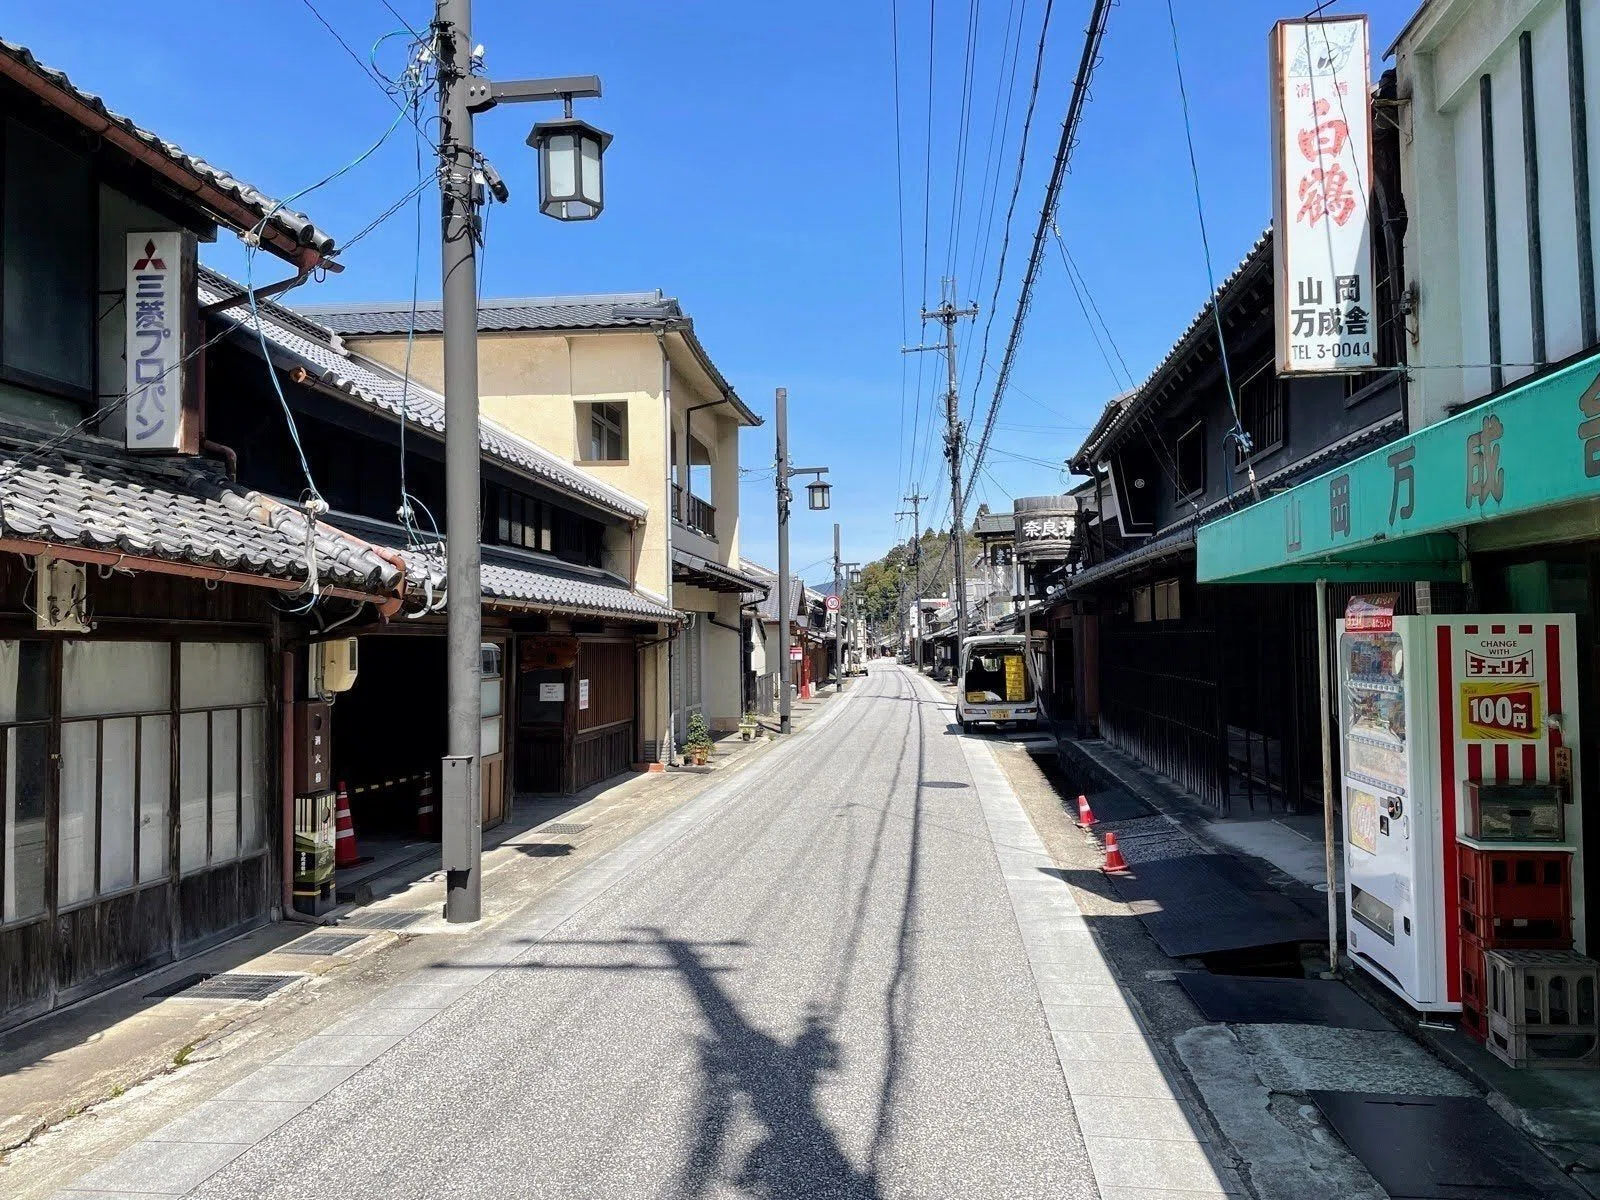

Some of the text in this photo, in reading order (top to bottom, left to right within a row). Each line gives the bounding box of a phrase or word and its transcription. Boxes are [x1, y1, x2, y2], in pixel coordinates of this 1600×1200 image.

[1296, 98, 1356, 228] 白鶴
[1298, 274, 1361, 306] 山岡
[136, 274, 171, 441] 三菱プロパン
[1291, 342, 1370, 360] TEL 3-0044
[1480, 640, 1518, 648] CHANGE
[1489, 648, 1510, 656] WITH
[1470, 656, 1529, 676] チェリオ
